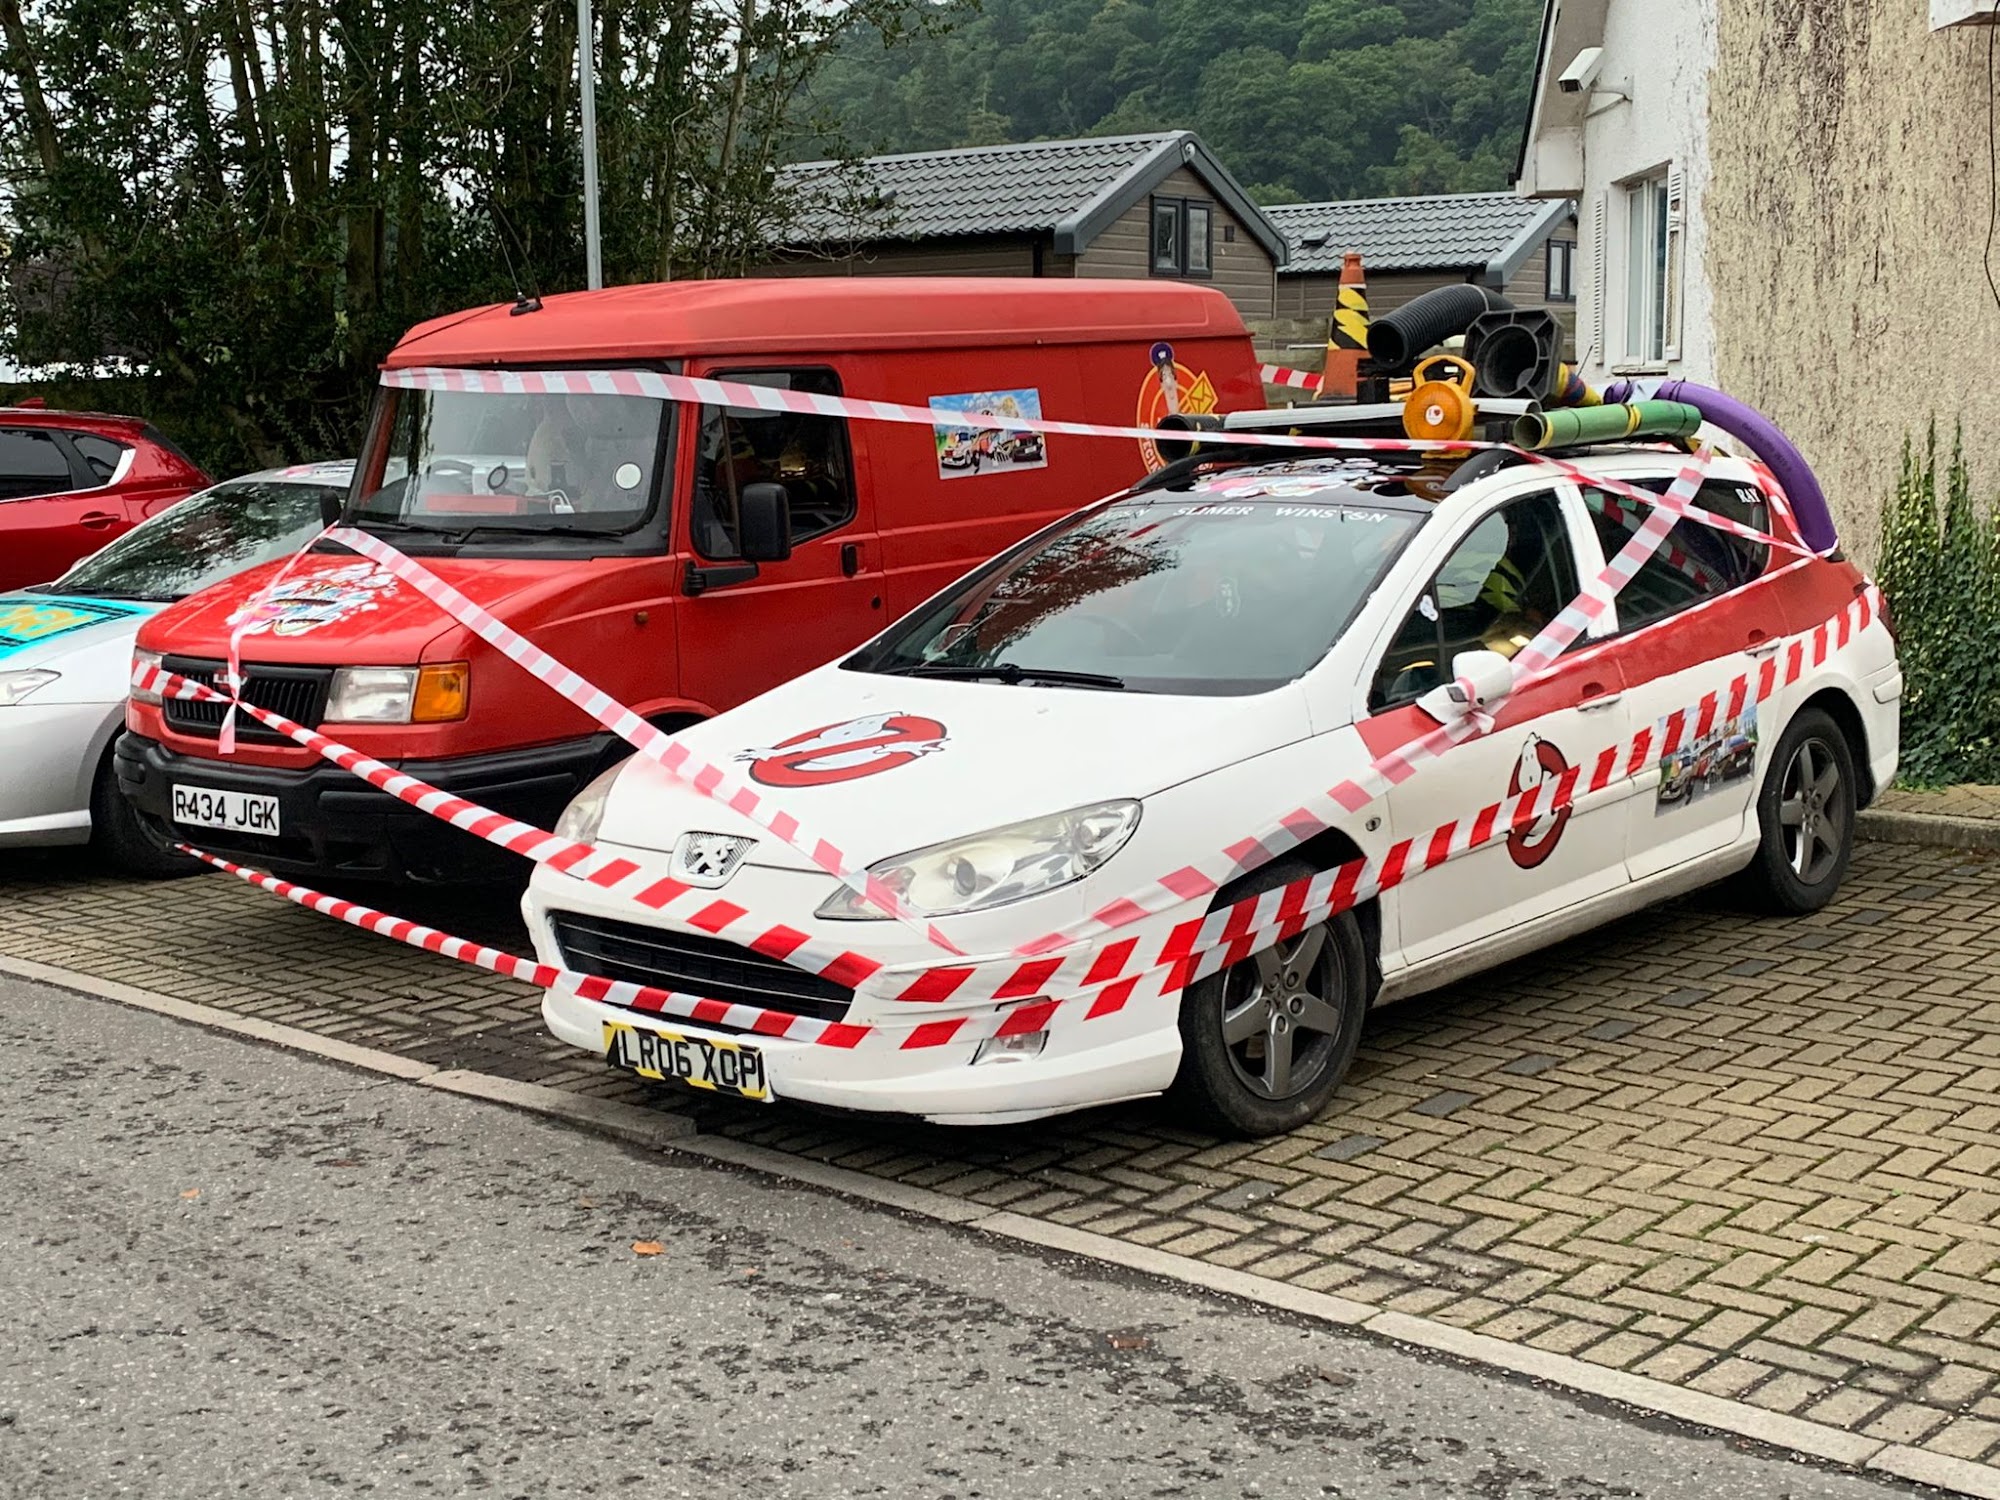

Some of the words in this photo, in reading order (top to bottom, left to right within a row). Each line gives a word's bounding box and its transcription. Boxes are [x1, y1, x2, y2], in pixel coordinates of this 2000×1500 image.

[1140, 422, 1163, 475] SECIA
[1173, 505, 1254, 517] SLIMER
[1274, 505, 1389, 524] WINSTON
[1735, 488, 1761, 503] RAY
[175, 790, 226, 824] R434
[235, 798, 277, 831] JGK
[621, 1029, 692, 1078] LR06
[700, 1042, 757, 1089] XOP
